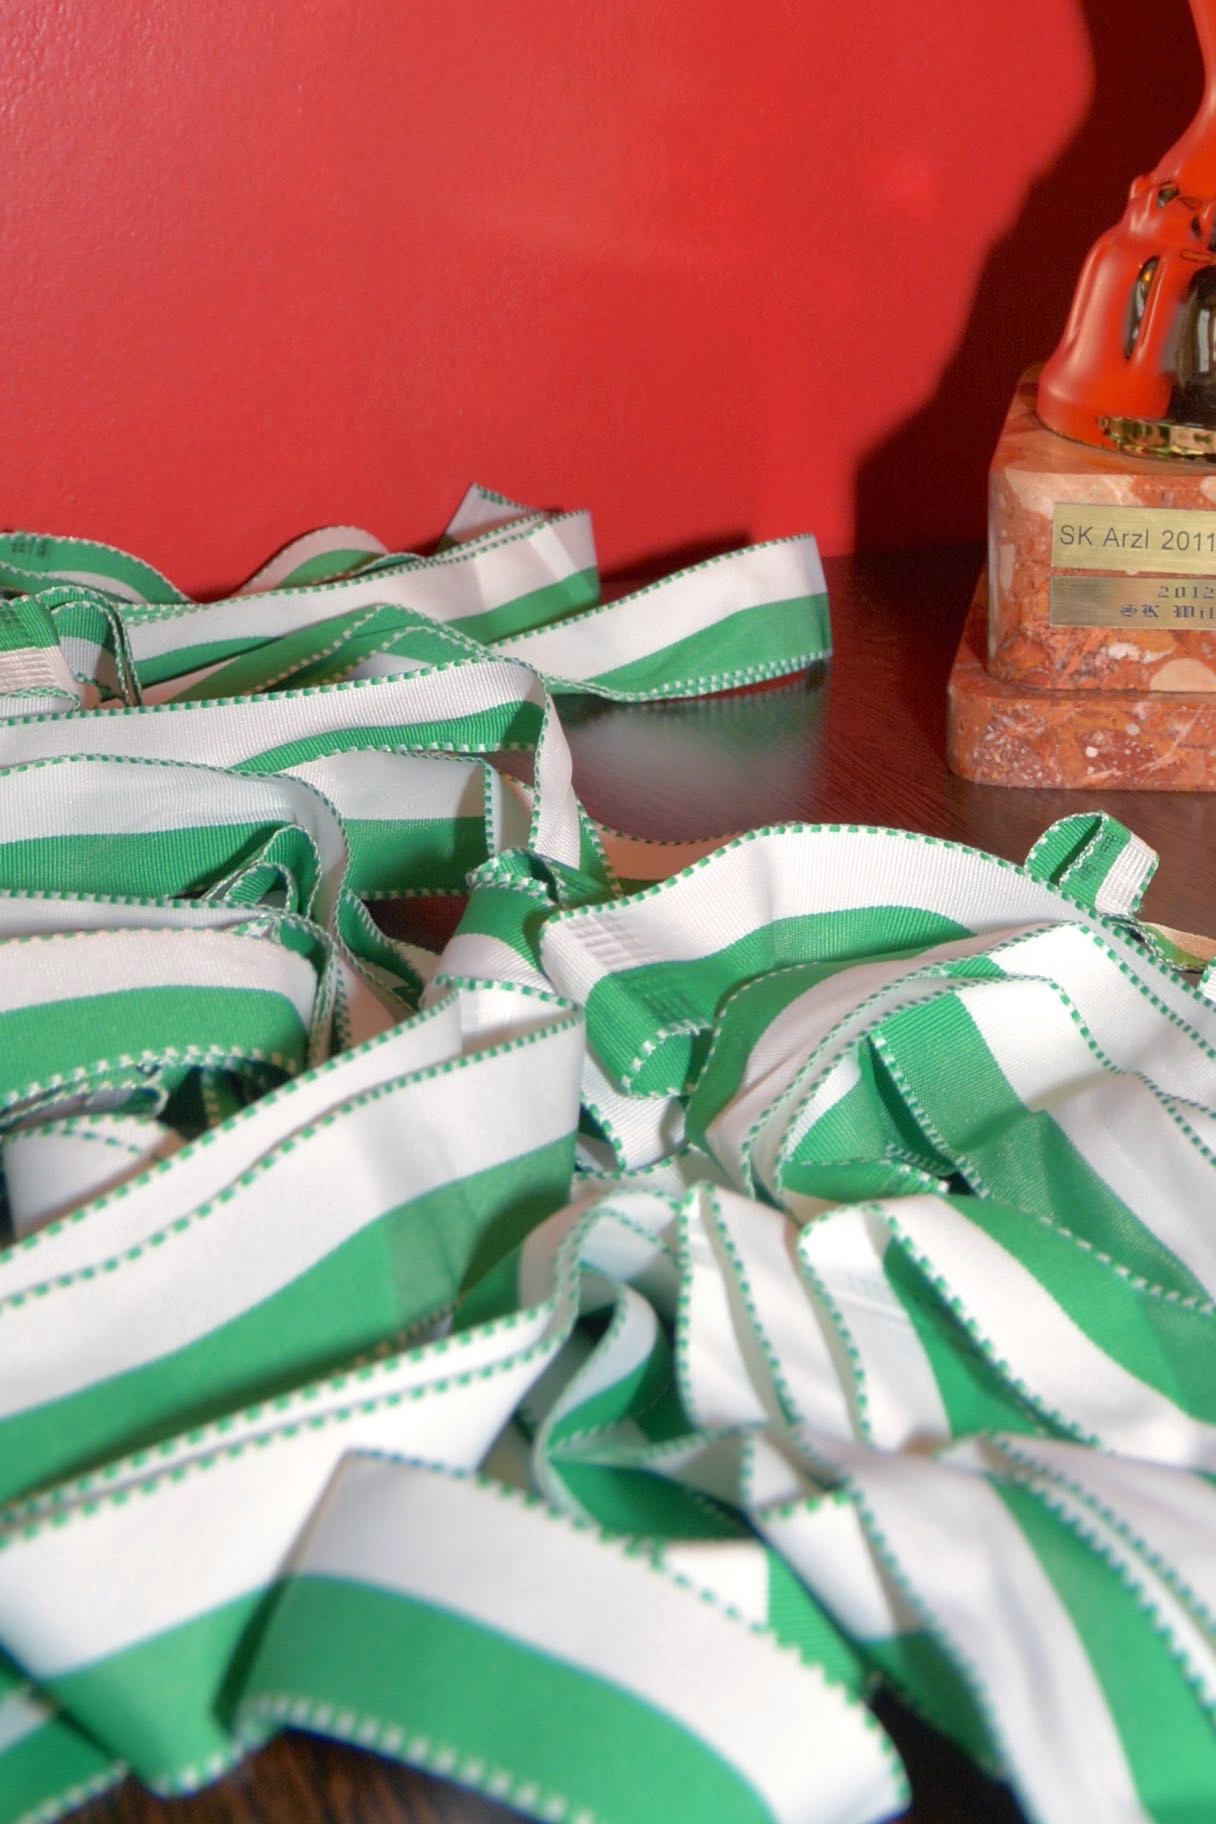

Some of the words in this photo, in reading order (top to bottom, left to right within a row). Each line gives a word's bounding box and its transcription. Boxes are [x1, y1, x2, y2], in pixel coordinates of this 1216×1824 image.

[1059, 524, 1093, 546] SK
[1102, 526, 1149, 550] Arzl
[1161, 529, 1216, 553] 2011
[1158, 585, 1215, 599] 2012
[1120, 603, 1160, 618] SK
